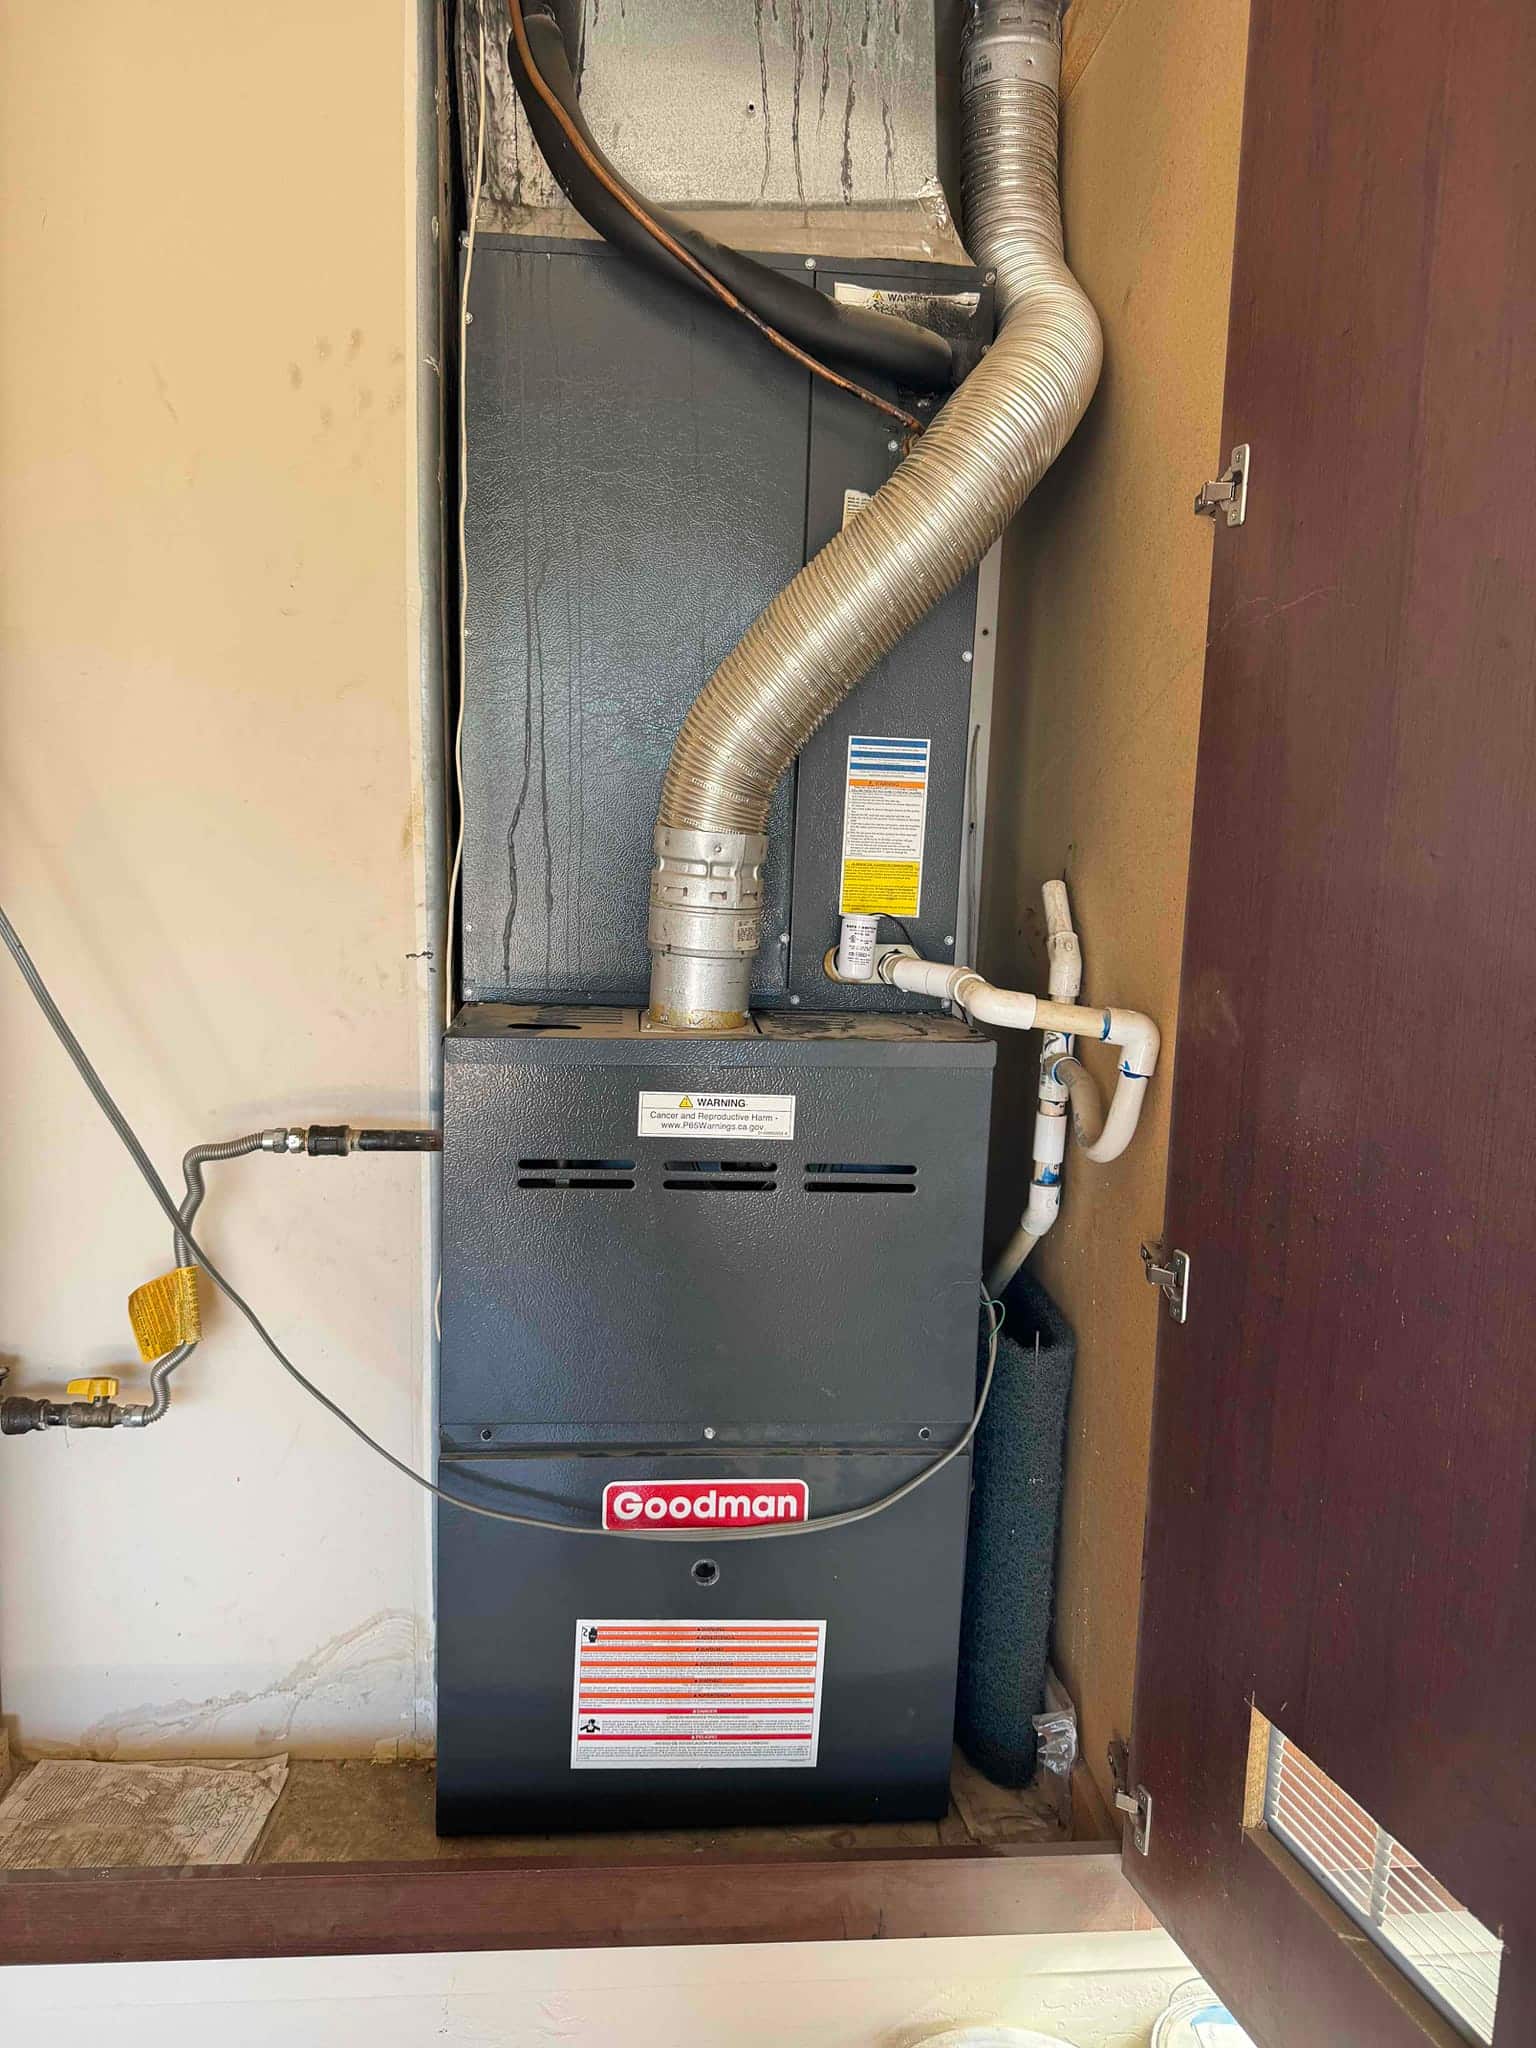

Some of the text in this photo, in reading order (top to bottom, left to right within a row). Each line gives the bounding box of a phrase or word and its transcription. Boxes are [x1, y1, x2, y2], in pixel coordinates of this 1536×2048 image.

[697, 1098, 746, 1108] WARNING
[650, 1110, 678, 1119] Cancer
[698, 1112, 750, 1121] Reproductive
[613, 1490, 797, 1520] Goodman
